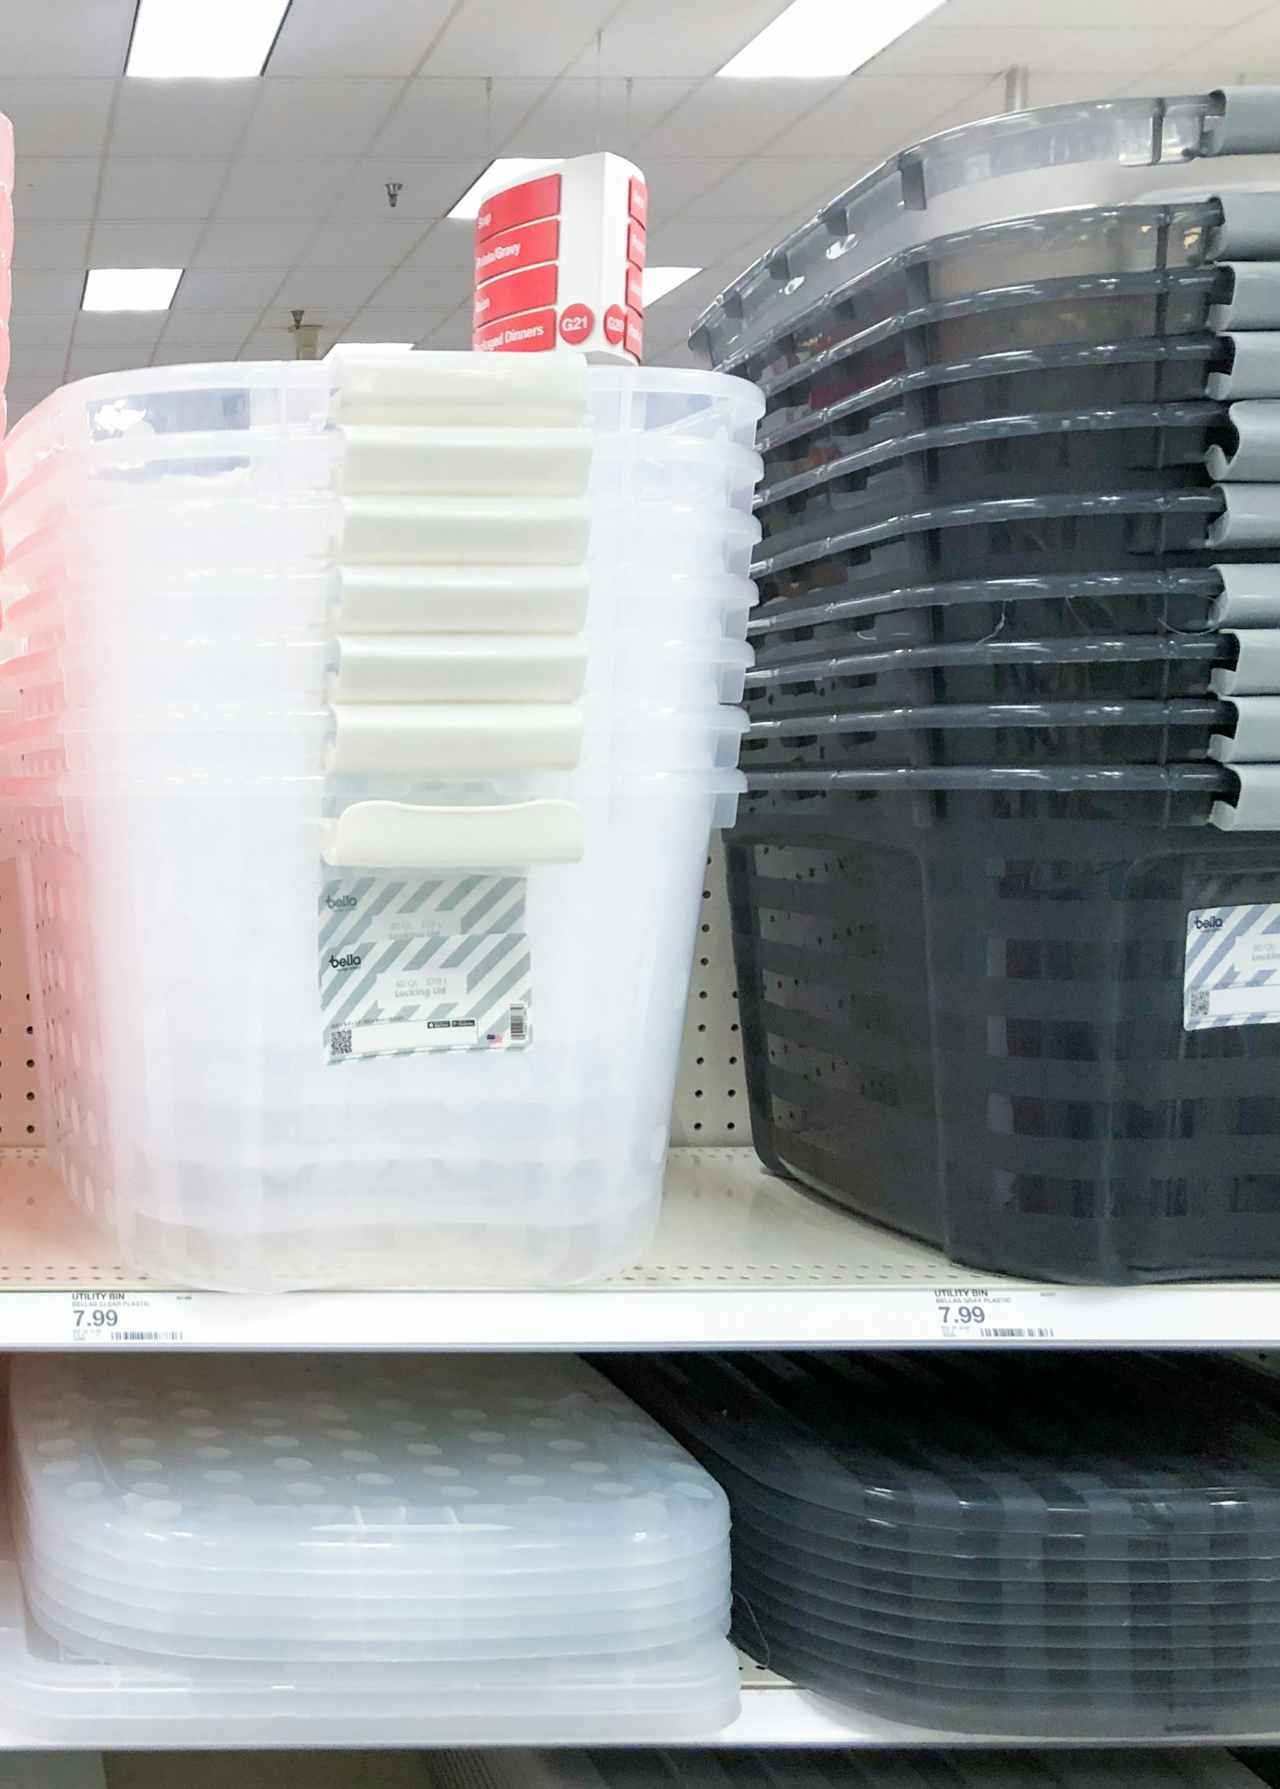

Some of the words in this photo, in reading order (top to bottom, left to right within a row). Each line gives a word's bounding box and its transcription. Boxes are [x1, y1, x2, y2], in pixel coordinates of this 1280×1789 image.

[561, 315, 588, 332] G21
[505, 325, 545, 344] Dinners
[326, 895, 358, 910] bella
[1194, 916, 1223, 929] bella
[329, 953, 362, 969] bella
[72, 1292, 106, 1301] UTILITY
[108, 1292, 125, 1300] BIN
[934, 1288, 969, 1297] UTILITY
[972, 1288, 988, 1297] BIN
[73, 1309, 118, 1327] 7.99
[938, 1306, 986, 1324] 7.99
